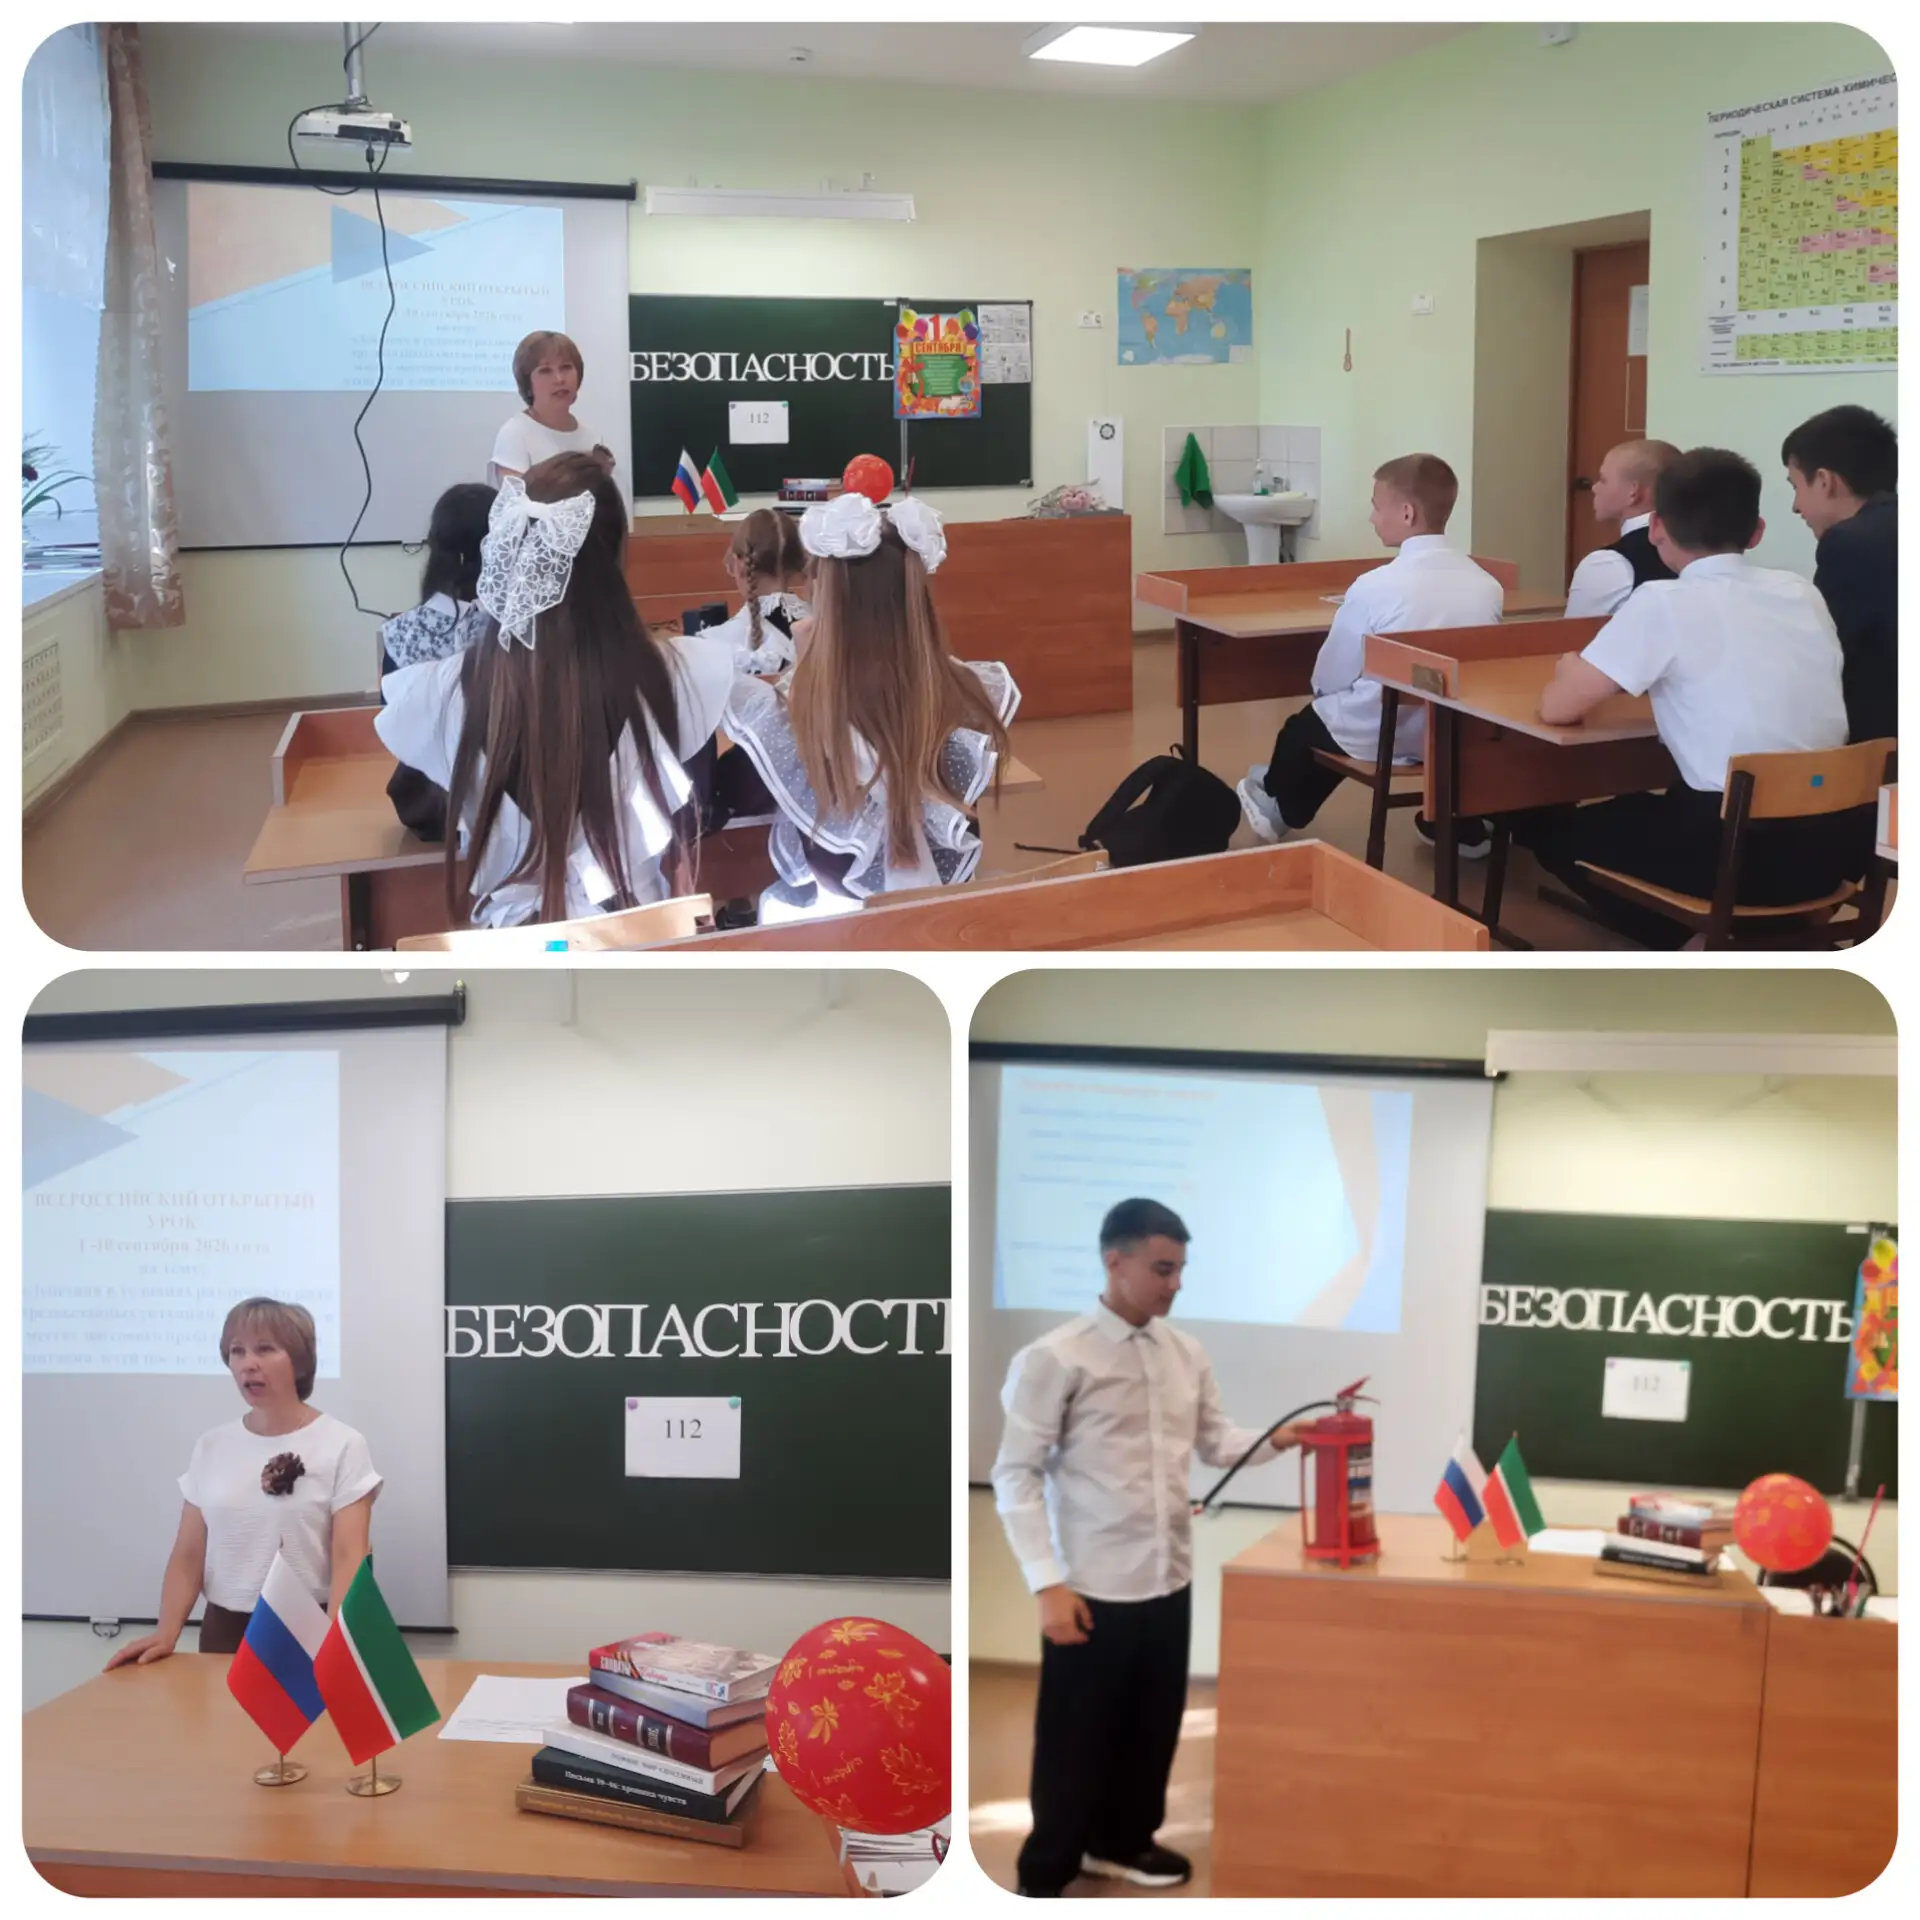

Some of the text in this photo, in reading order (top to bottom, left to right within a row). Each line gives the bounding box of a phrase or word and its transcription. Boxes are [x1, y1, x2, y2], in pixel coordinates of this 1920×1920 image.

[1708, 98, 1788, 124] ПЕРИОДИЧЕСКАЯ
[1790, 86, 1839, 107] СИСТЕМА
[361, 279, 477, 295] ВСЕОССИЙСКИЙ
[929, 314, 941, 341] 1
[915, 342, 962, 353] СЕНТЯБРЯ
[630, 351, 896, 382] БЕЗОПАСНОСТЬ
[750, 412, 769, 424] 112
[202, 1190, 315, 1210] ОТКРЫТЫЙ
[147, 1216, 197, 1231] УРОК
[1479, 1283, 1856, 1343] БЕЗОПАСНОСТЬ
[1632, 1375, 1661, 1393] 112
[664, 1418, 703, 1439] 112
[564, 1770, 595, 1785] Письма
[621, 1784, 657, 1799] хроника
[658, 1791, 688, 1805] чувств
